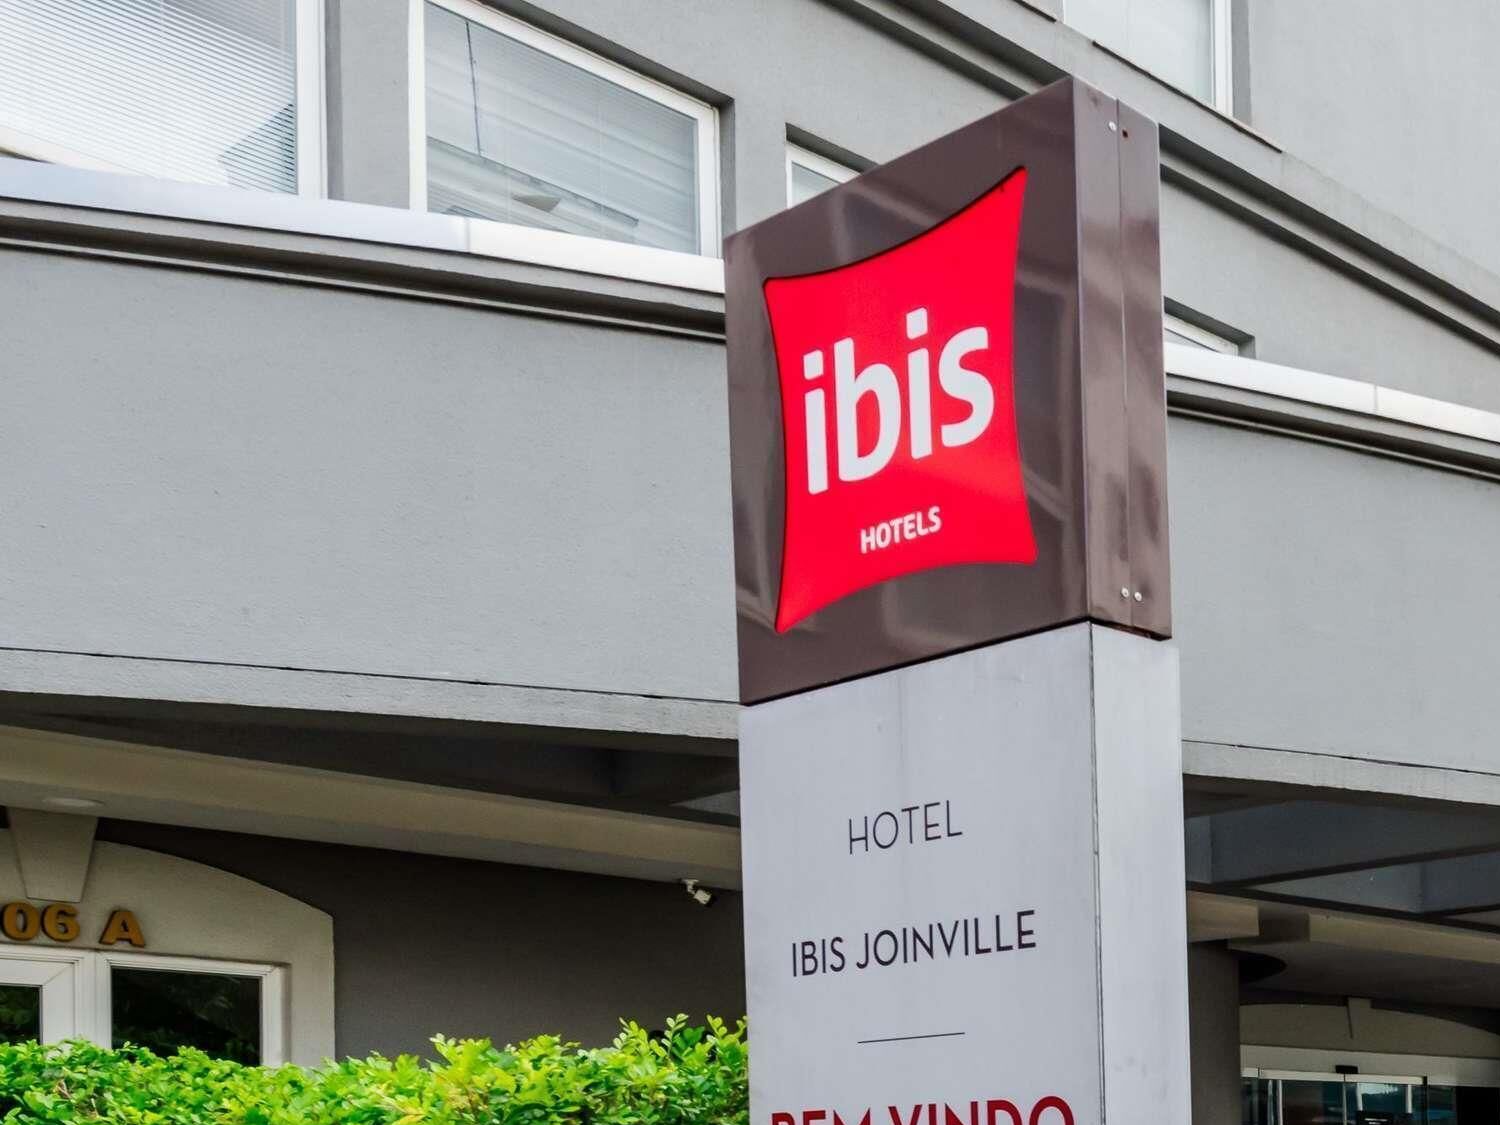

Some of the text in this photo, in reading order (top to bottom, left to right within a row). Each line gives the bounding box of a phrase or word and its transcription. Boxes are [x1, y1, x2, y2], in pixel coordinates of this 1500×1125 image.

[803, 307, 996, 495] ibis
[860, 506, 942, 554] HOTELS
[848, 800, 963, 855] HOTEL
[99, 908, 146, 948] A
[791, 909, 1037, 977] IBIS JOINVILLE
